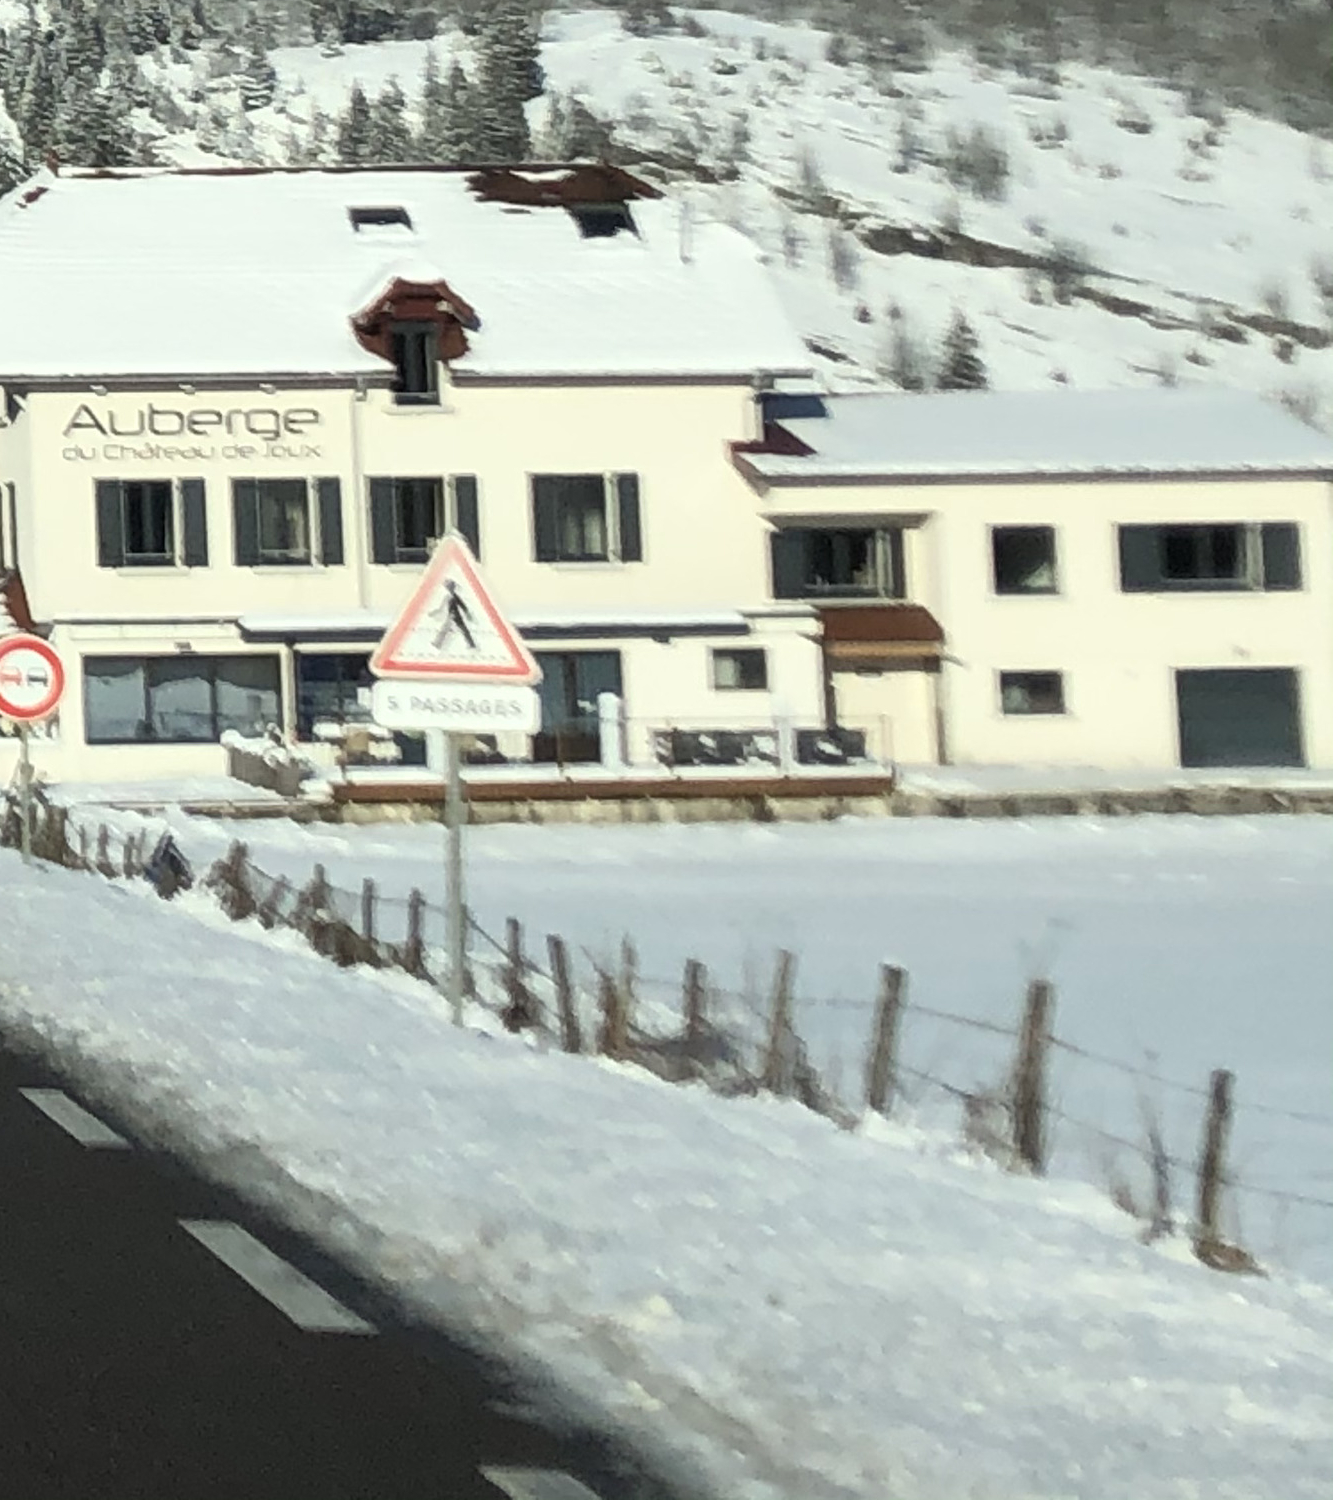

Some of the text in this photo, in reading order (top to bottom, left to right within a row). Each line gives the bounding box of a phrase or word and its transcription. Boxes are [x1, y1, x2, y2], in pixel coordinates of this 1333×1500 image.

[62, 402, 321, 441] Auberge
[62, 445, 96, 461] du
[221, 444, 256, 460] de
[409, 695, 525, 717] PASSAGES
